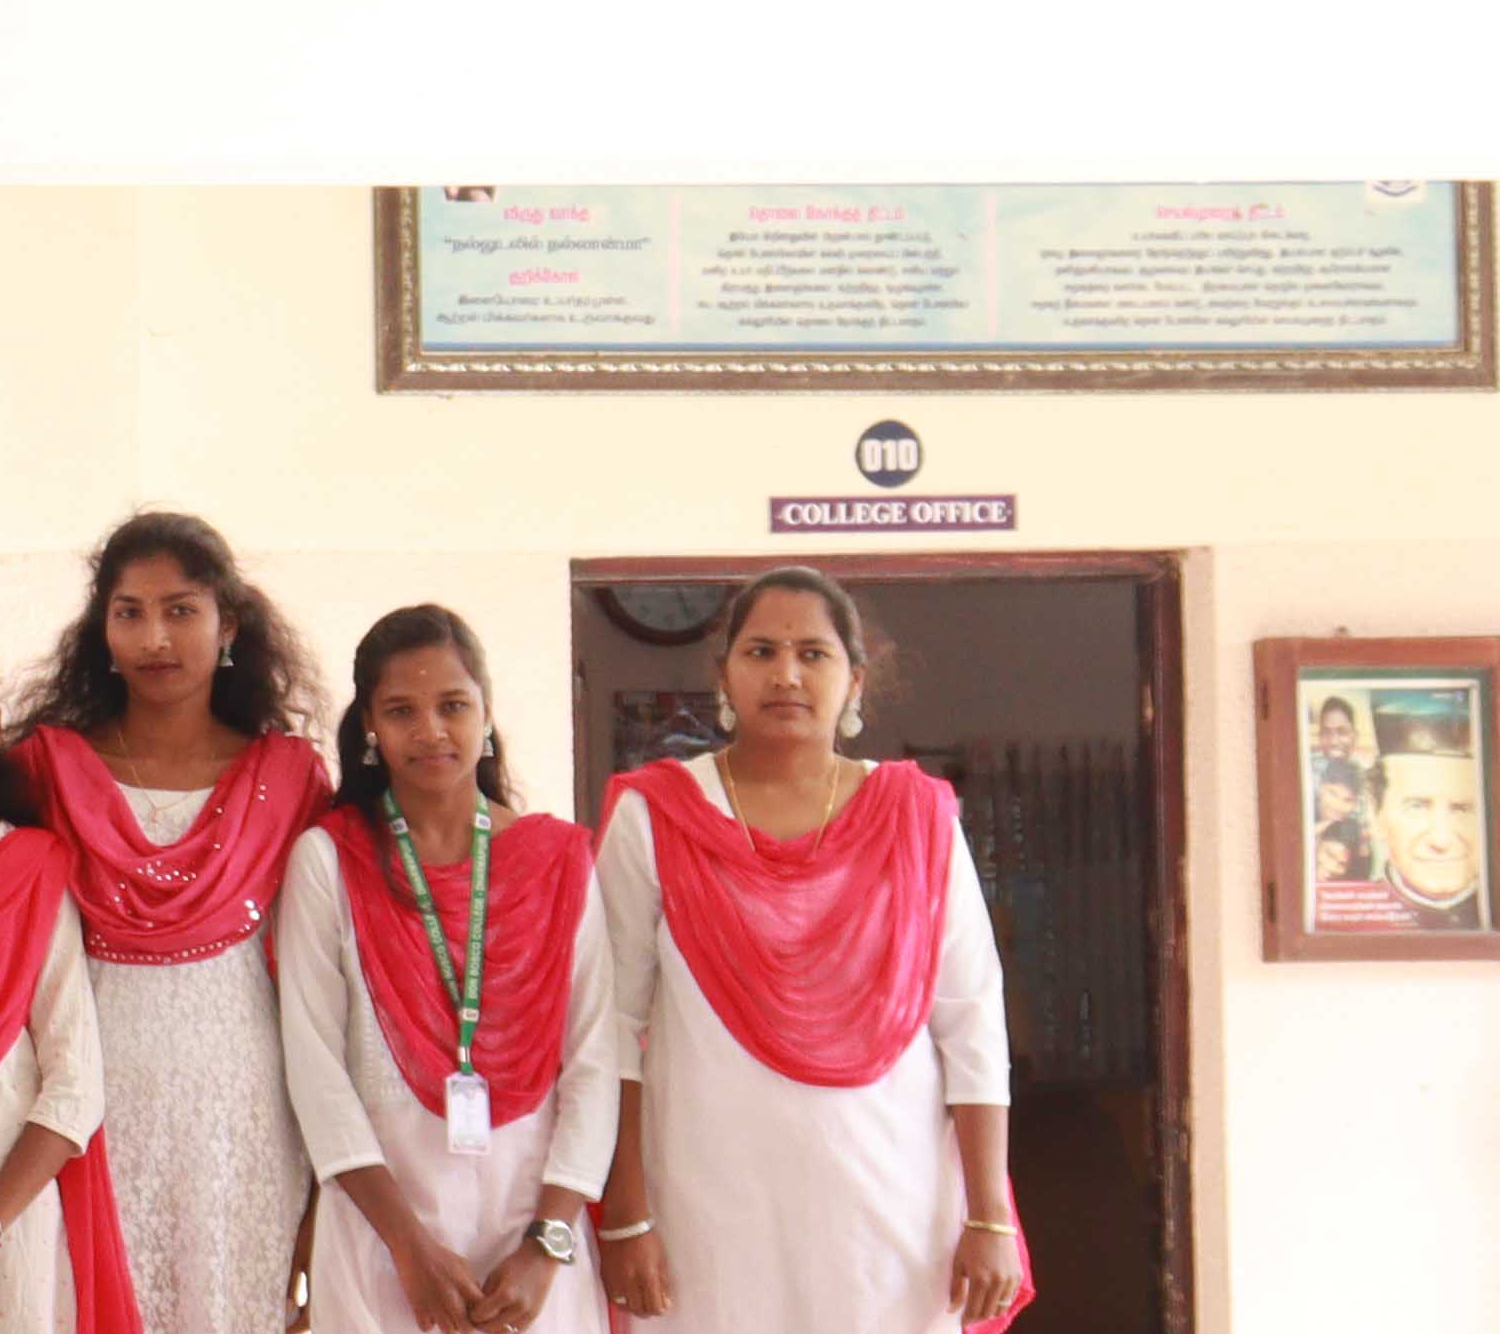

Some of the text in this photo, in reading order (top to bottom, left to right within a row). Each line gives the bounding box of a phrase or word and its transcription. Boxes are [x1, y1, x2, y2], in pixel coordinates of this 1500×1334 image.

[861, 438, 919, 473] 010
[783, 500, 1008, 526] COLLEGE OFFICE
